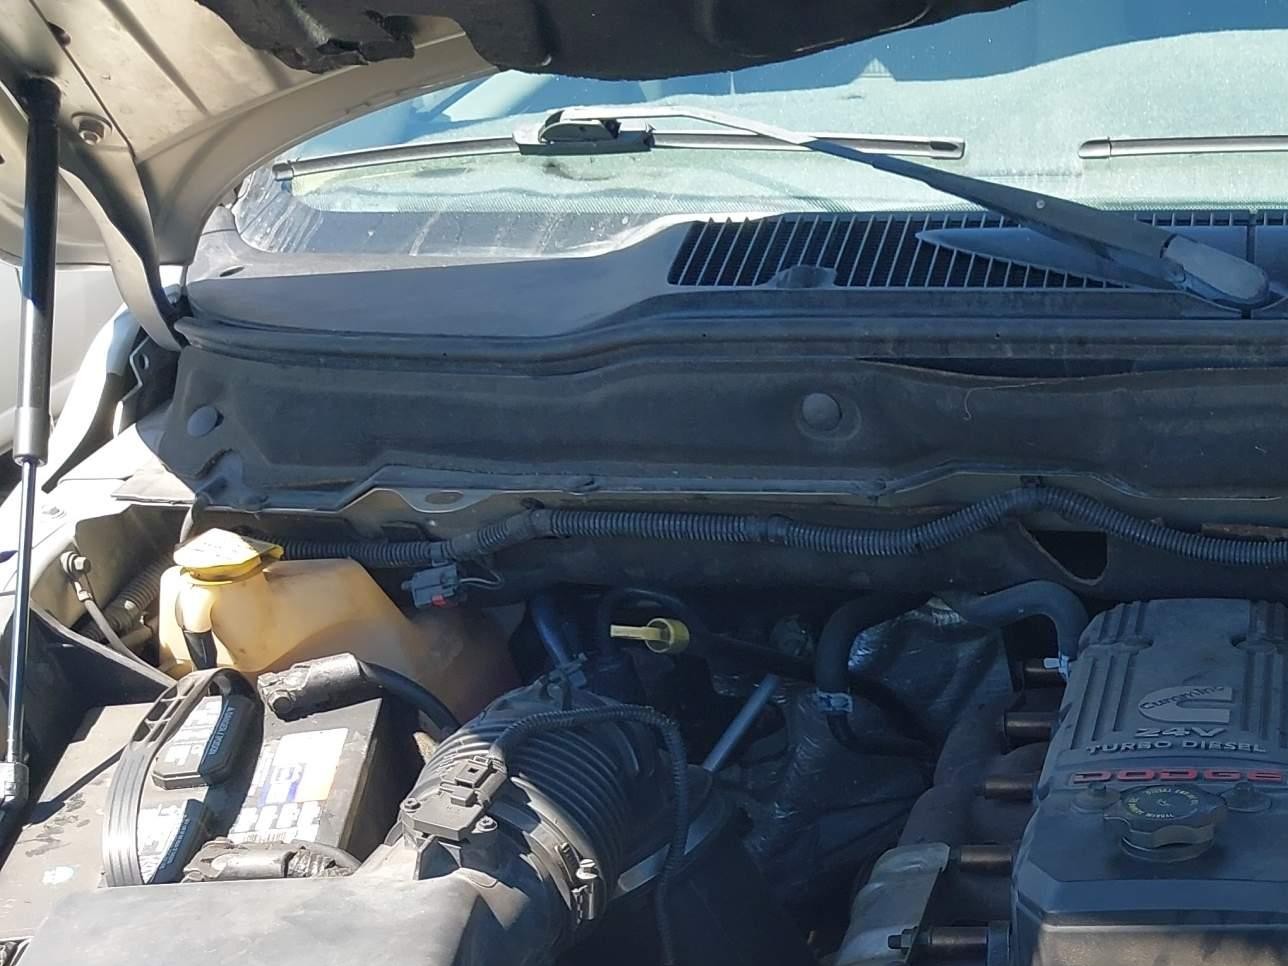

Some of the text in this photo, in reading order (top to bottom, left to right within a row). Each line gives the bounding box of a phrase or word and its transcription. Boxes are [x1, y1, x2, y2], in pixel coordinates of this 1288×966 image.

[1135, 727, 1227, 738] 24V
[1087, 739, 1266, 755] TURBO DIESEL
[1072, 767, 1283, 785] DODGE
